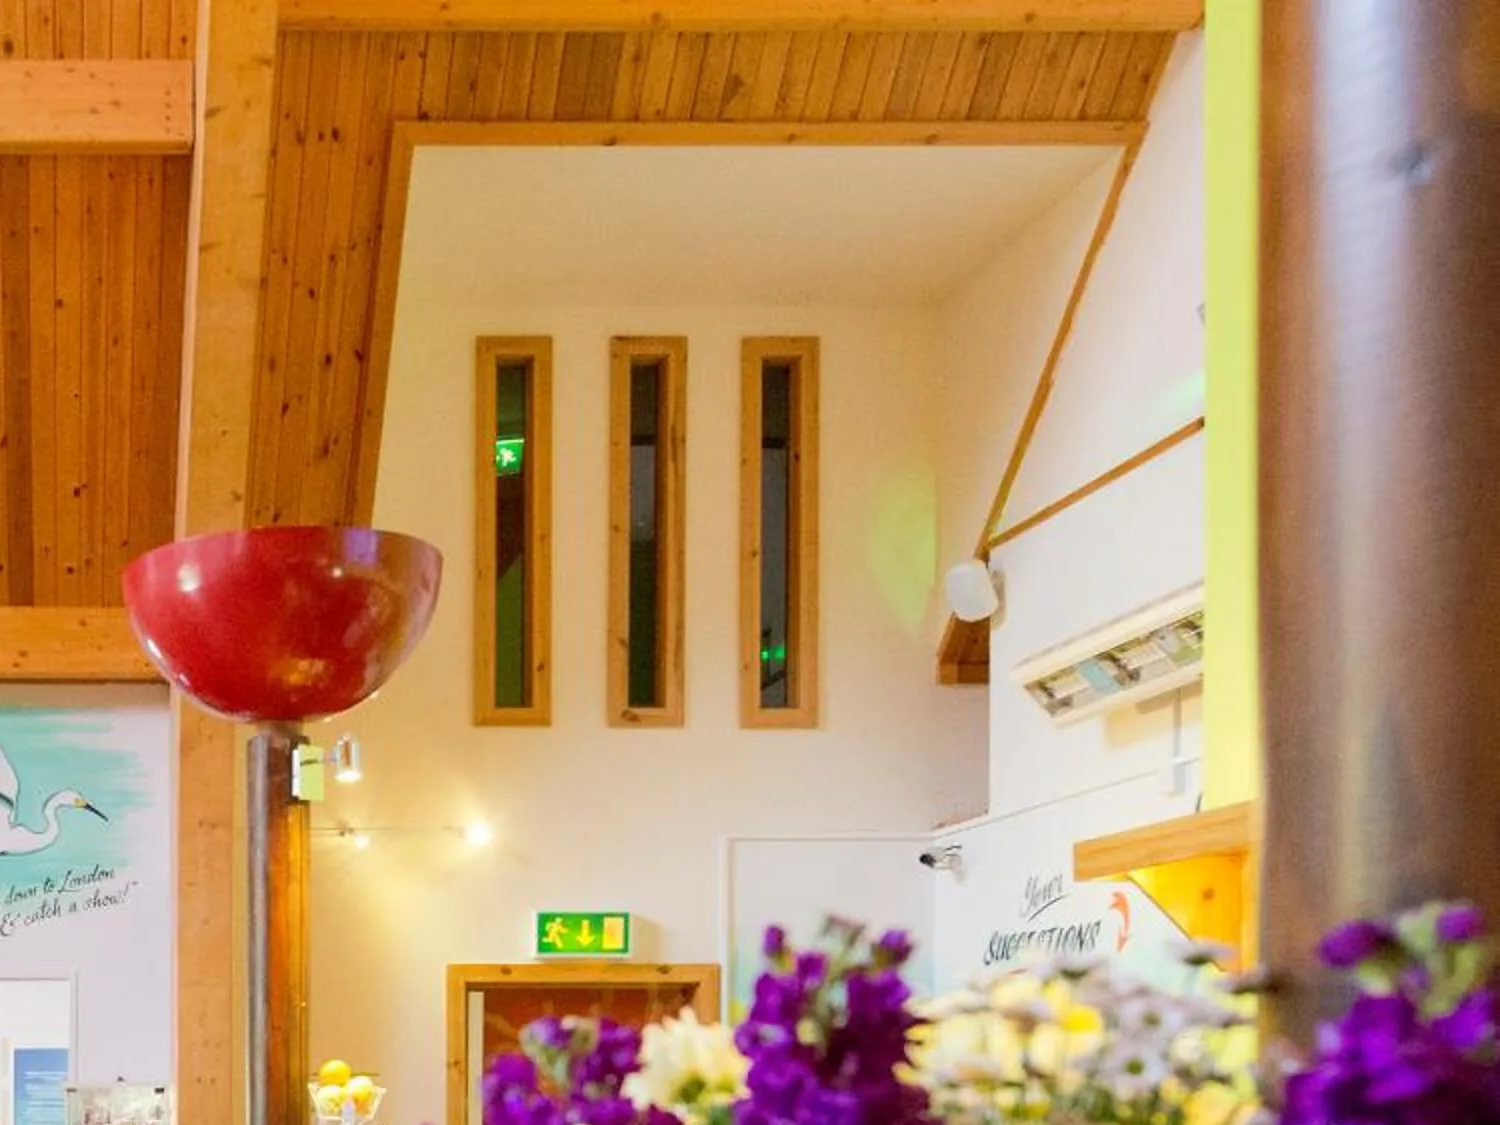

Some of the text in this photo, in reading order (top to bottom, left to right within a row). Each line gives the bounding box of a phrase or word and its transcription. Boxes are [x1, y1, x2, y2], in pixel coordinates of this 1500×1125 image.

[4, 884, 38, 905] down
[43, 876, 56, 894] to
[57, 863, 116, 894] London
[1019, 872, 1064, 917] Your
[0, 913, 21, 937] &
[23, 898, 62, 927] catch
[68, 903, 78, 913] a
